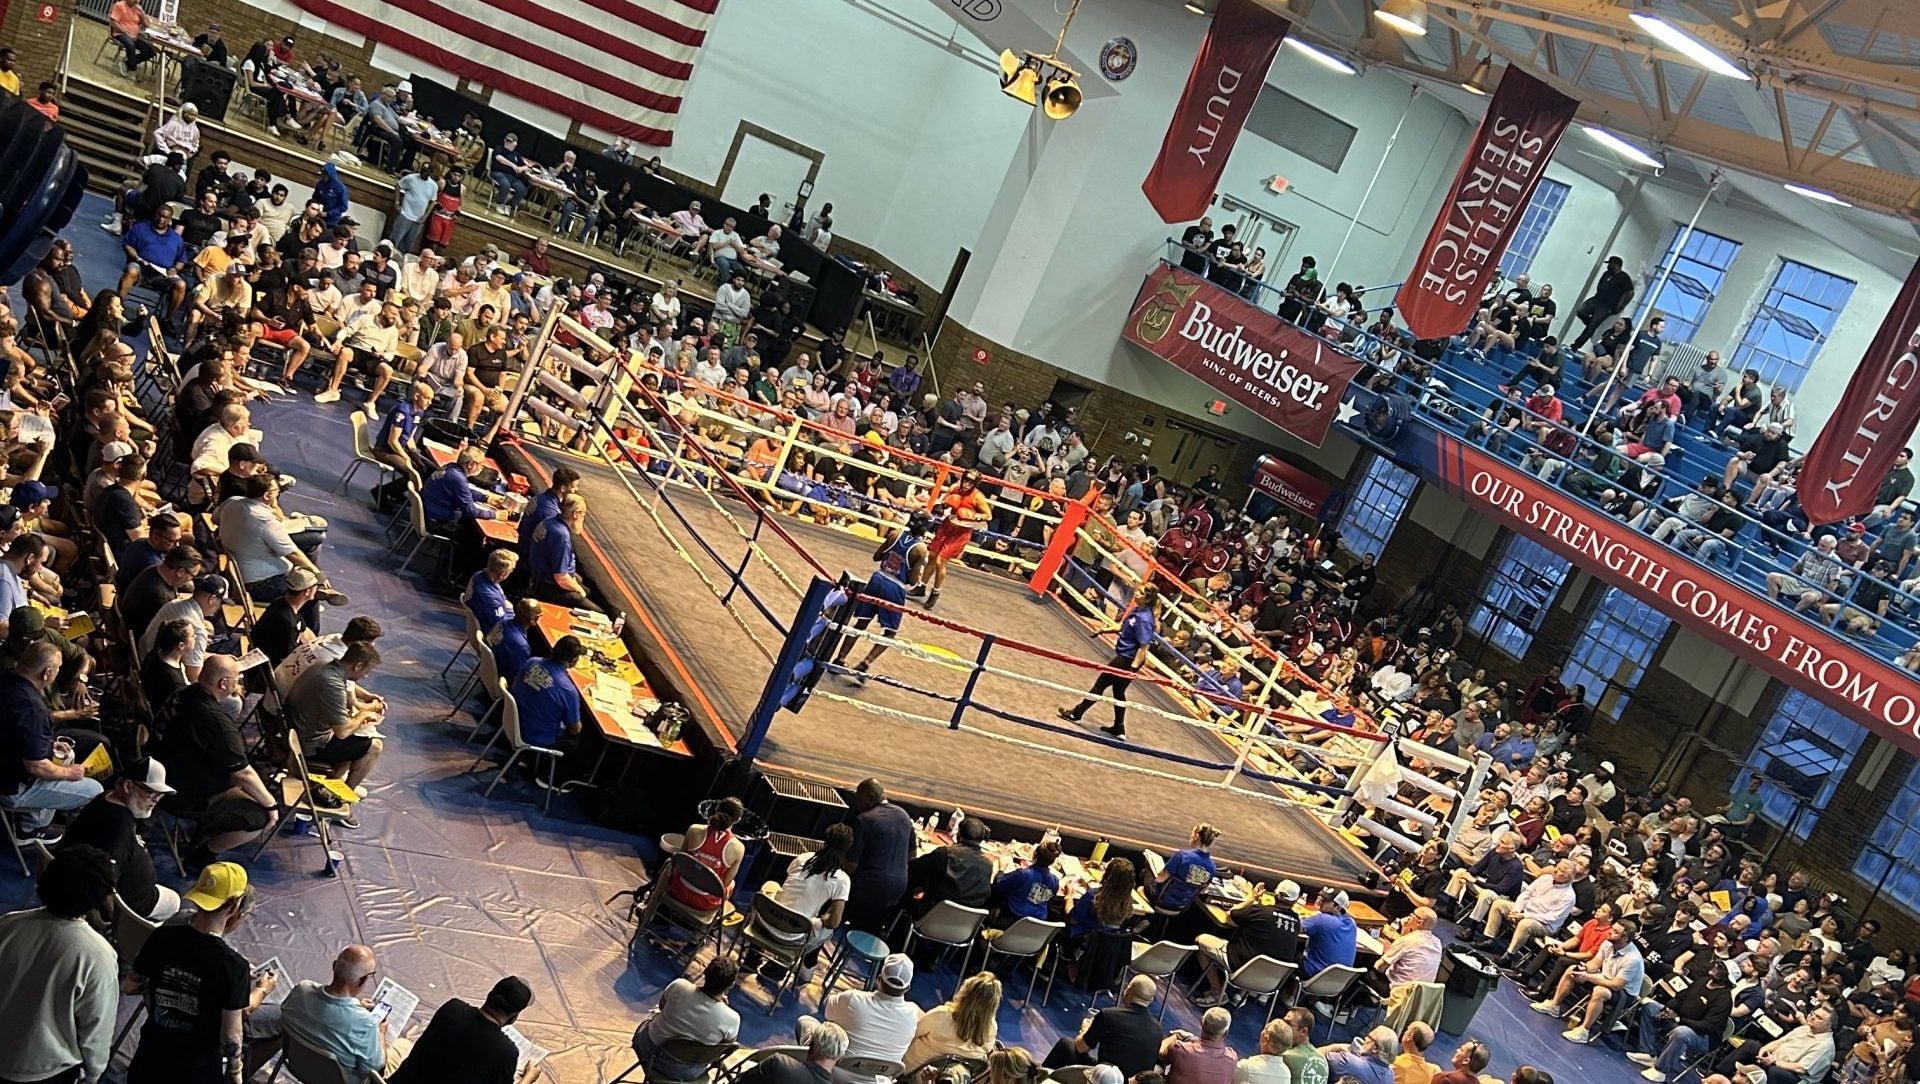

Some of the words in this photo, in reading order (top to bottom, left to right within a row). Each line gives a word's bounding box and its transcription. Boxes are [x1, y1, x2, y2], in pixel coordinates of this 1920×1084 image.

[1187, 62, 1243, 168] DUTY
[1419, 116, 1519, 296] SERVICE
[1444, 130, 1543, 306] SELFLESS
[1179, 301, 1329, 410] Budweiser
[1202, 357, 1227, 376] KING
[1228, 372, 1243, 385] OF
[1260, 474, 1316, 510] Budweiser
[1471, 471, 1525, 518] OUR
[1525, 500, 1670, 594] STRENGTH
[1671, 579, 1778, 651] COMES
[1778, 635, 1879, 712] FROM
